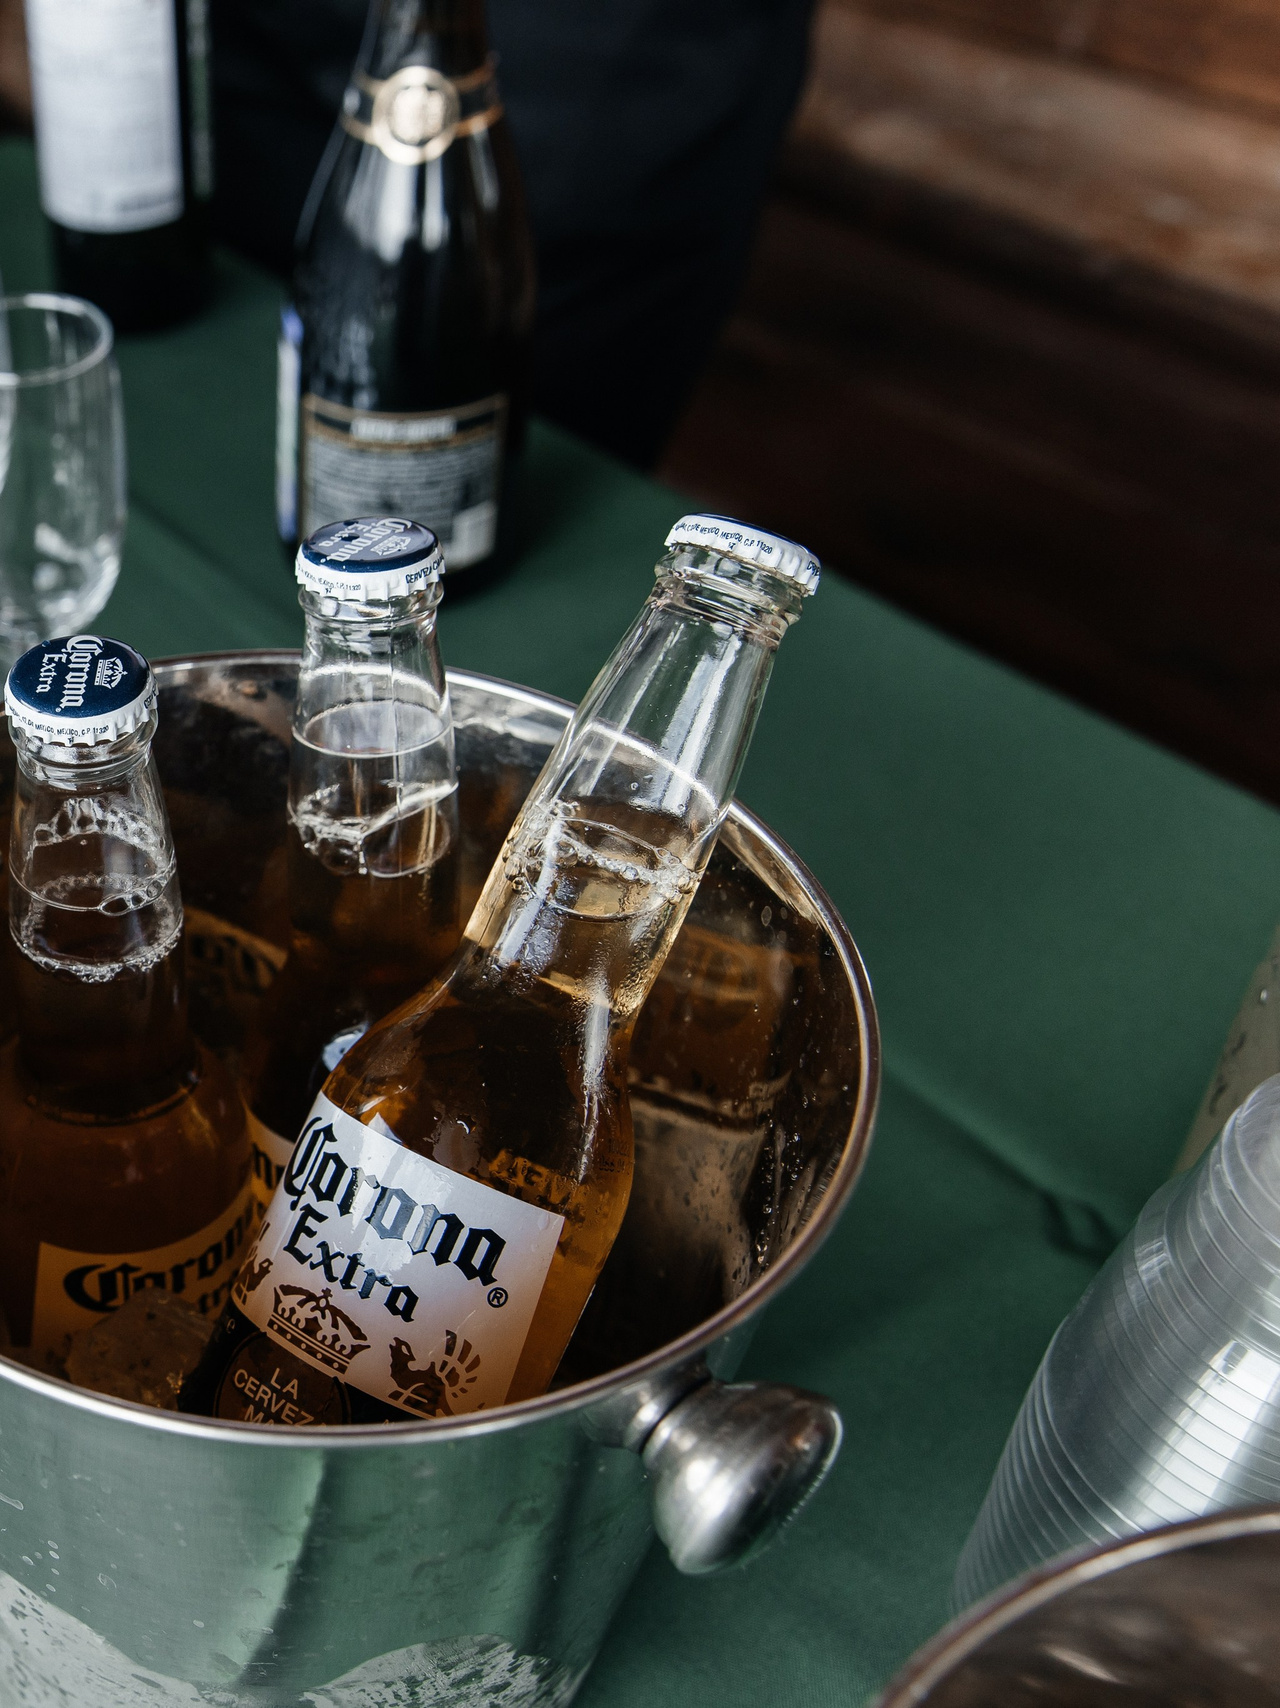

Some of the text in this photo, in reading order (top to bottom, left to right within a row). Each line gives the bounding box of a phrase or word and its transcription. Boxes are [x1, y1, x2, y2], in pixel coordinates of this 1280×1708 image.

[327, 518, 412, 562] Corona
[36, 653, 66, 694] Extra
[61, 635, 104, 708] Corona
[284, 1116, 507, 1287] Corona
[282, 1203, 420, 1323] Extra
[233, 1368, 324, 1426] CERVEZ
[270, 1367, 300, 1400] LA
